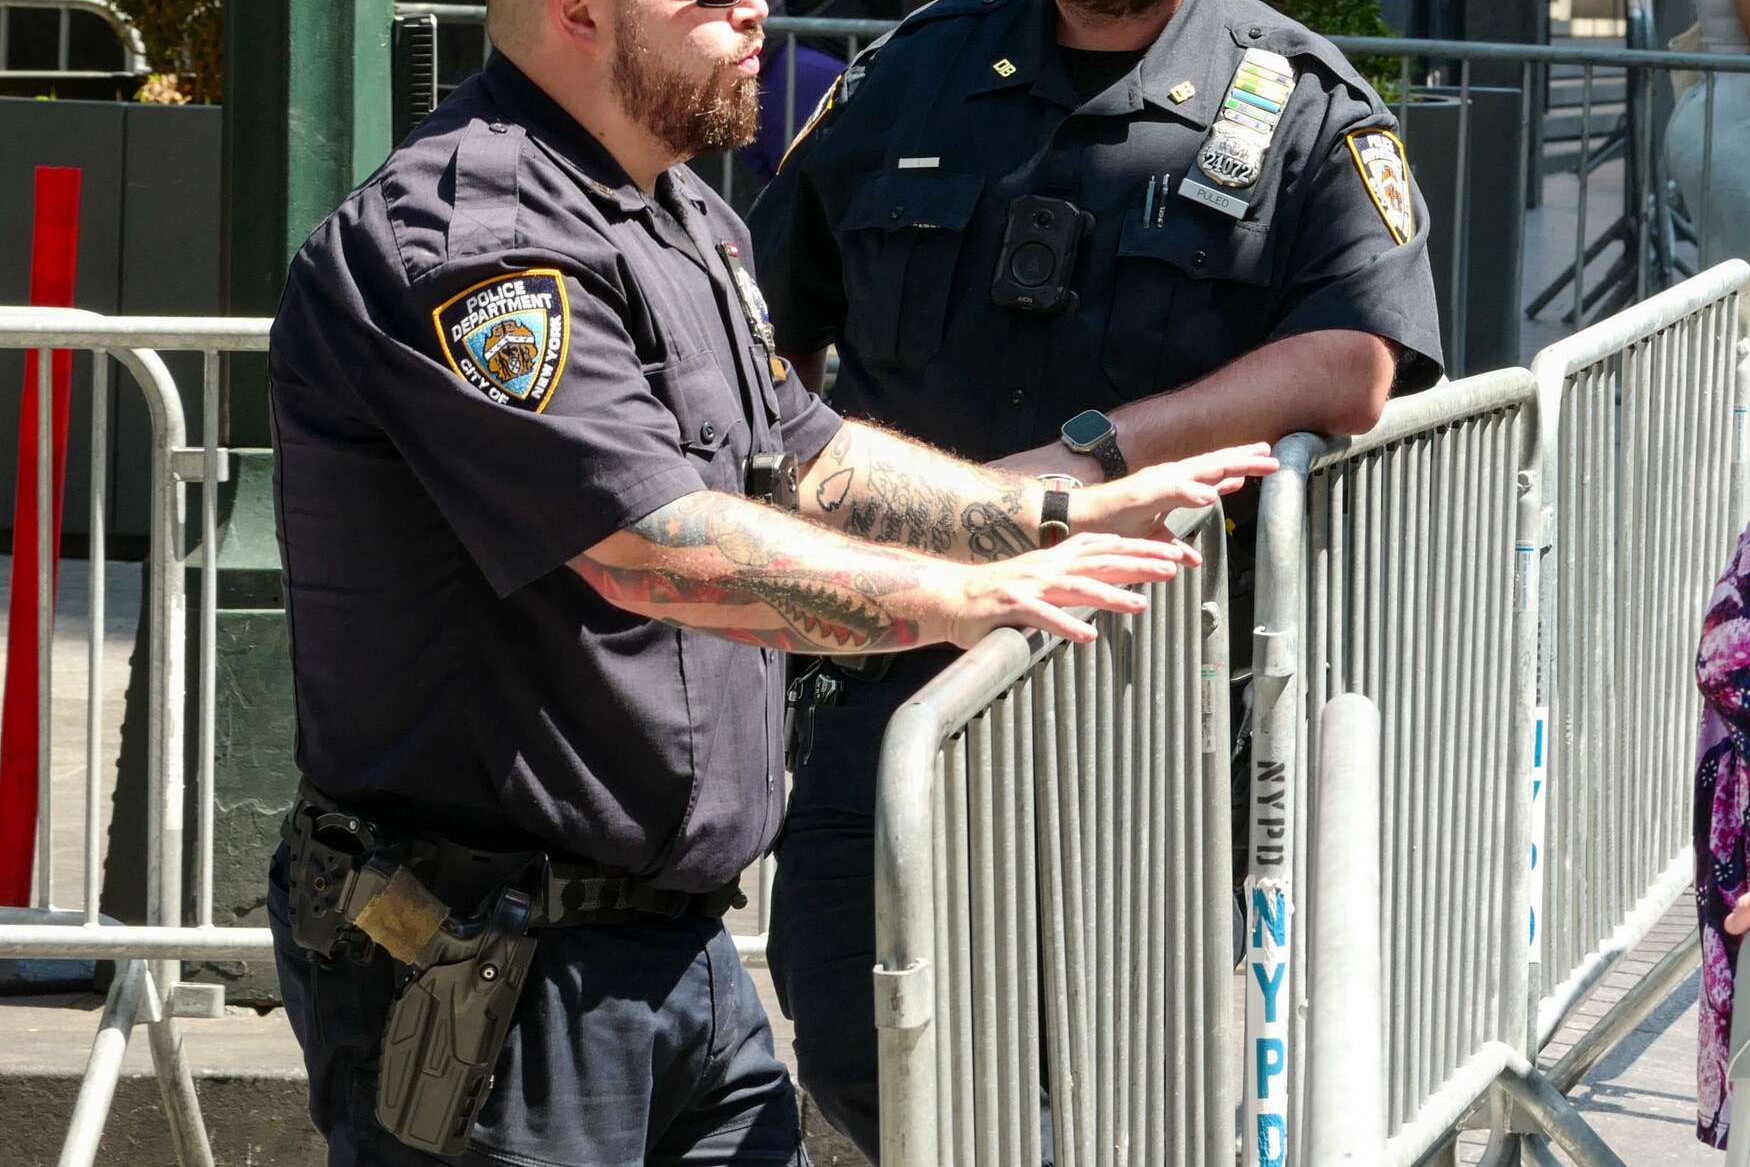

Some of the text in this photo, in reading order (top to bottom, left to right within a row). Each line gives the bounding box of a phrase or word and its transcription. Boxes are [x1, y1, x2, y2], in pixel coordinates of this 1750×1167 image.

[1202, 151, 1253, 182] 24072
[1197, 188, 1229, 208] PULEO
[451, 293, 553, 343] DEPARTMENT
[466, 280, 526, 314] POLICE
[531, 314, 562, 400] NEW YORK
[460, 358, 510, 405] CITY OF
[1256, 760, 1286, 866] NYPD
[1251, 886, 1287, 1167] NYPD
